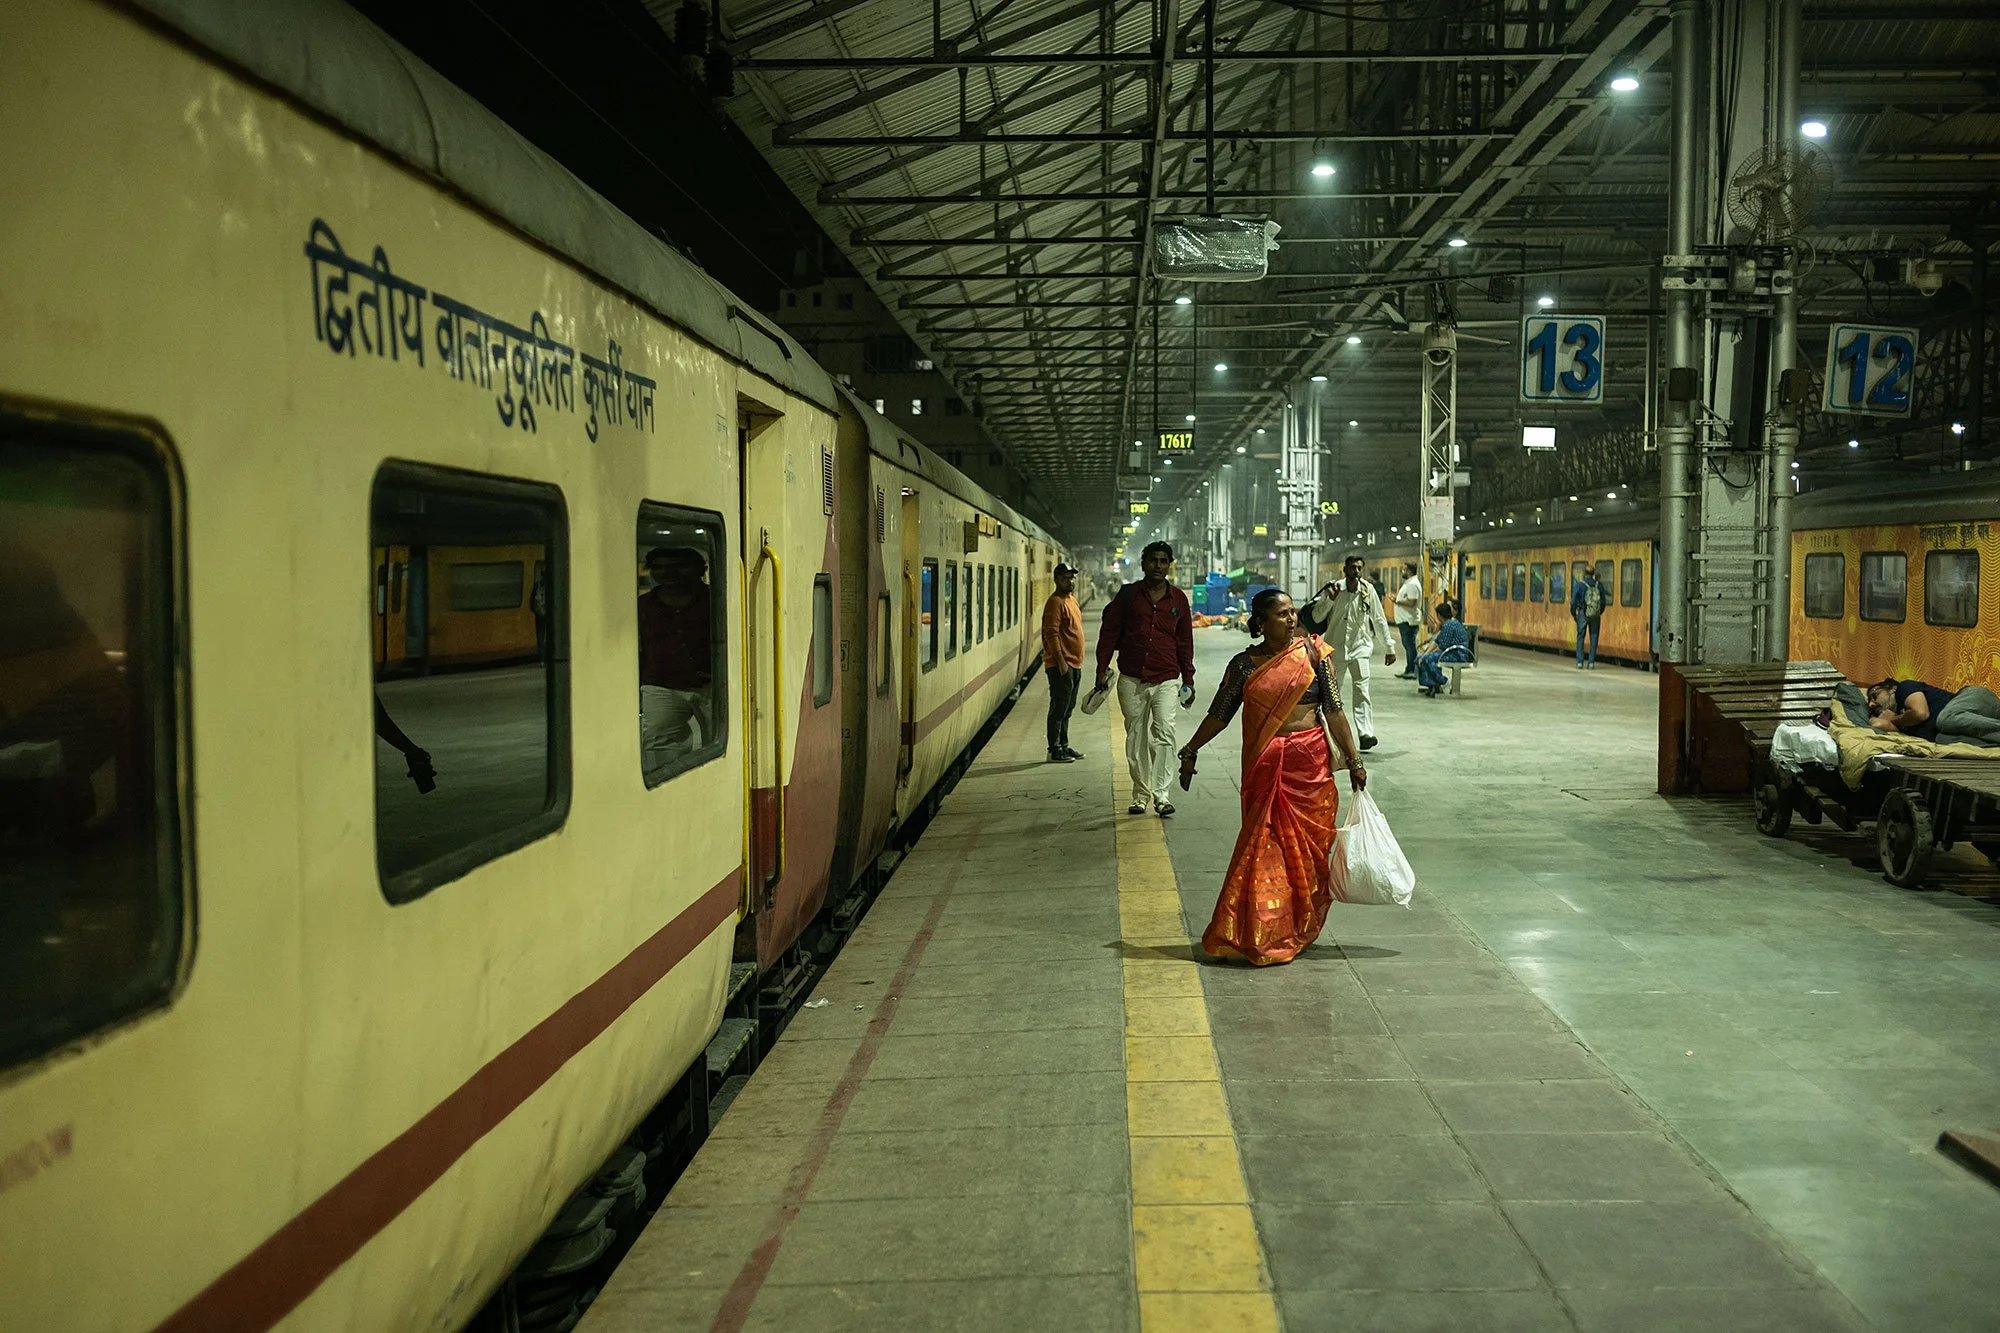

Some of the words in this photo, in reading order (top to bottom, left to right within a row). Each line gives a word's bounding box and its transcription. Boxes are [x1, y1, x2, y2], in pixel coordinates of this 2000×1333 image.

[304, 217, 427, 367] द्वितीय
[431, 291, 576, 434] वातानुकूलित
[625, 370, 657, 434] यान
[1528, 321, 1601, 394] 13
[1838, 331, 1915, 408] 12
[1160, 433, 1193, 449] 17617
